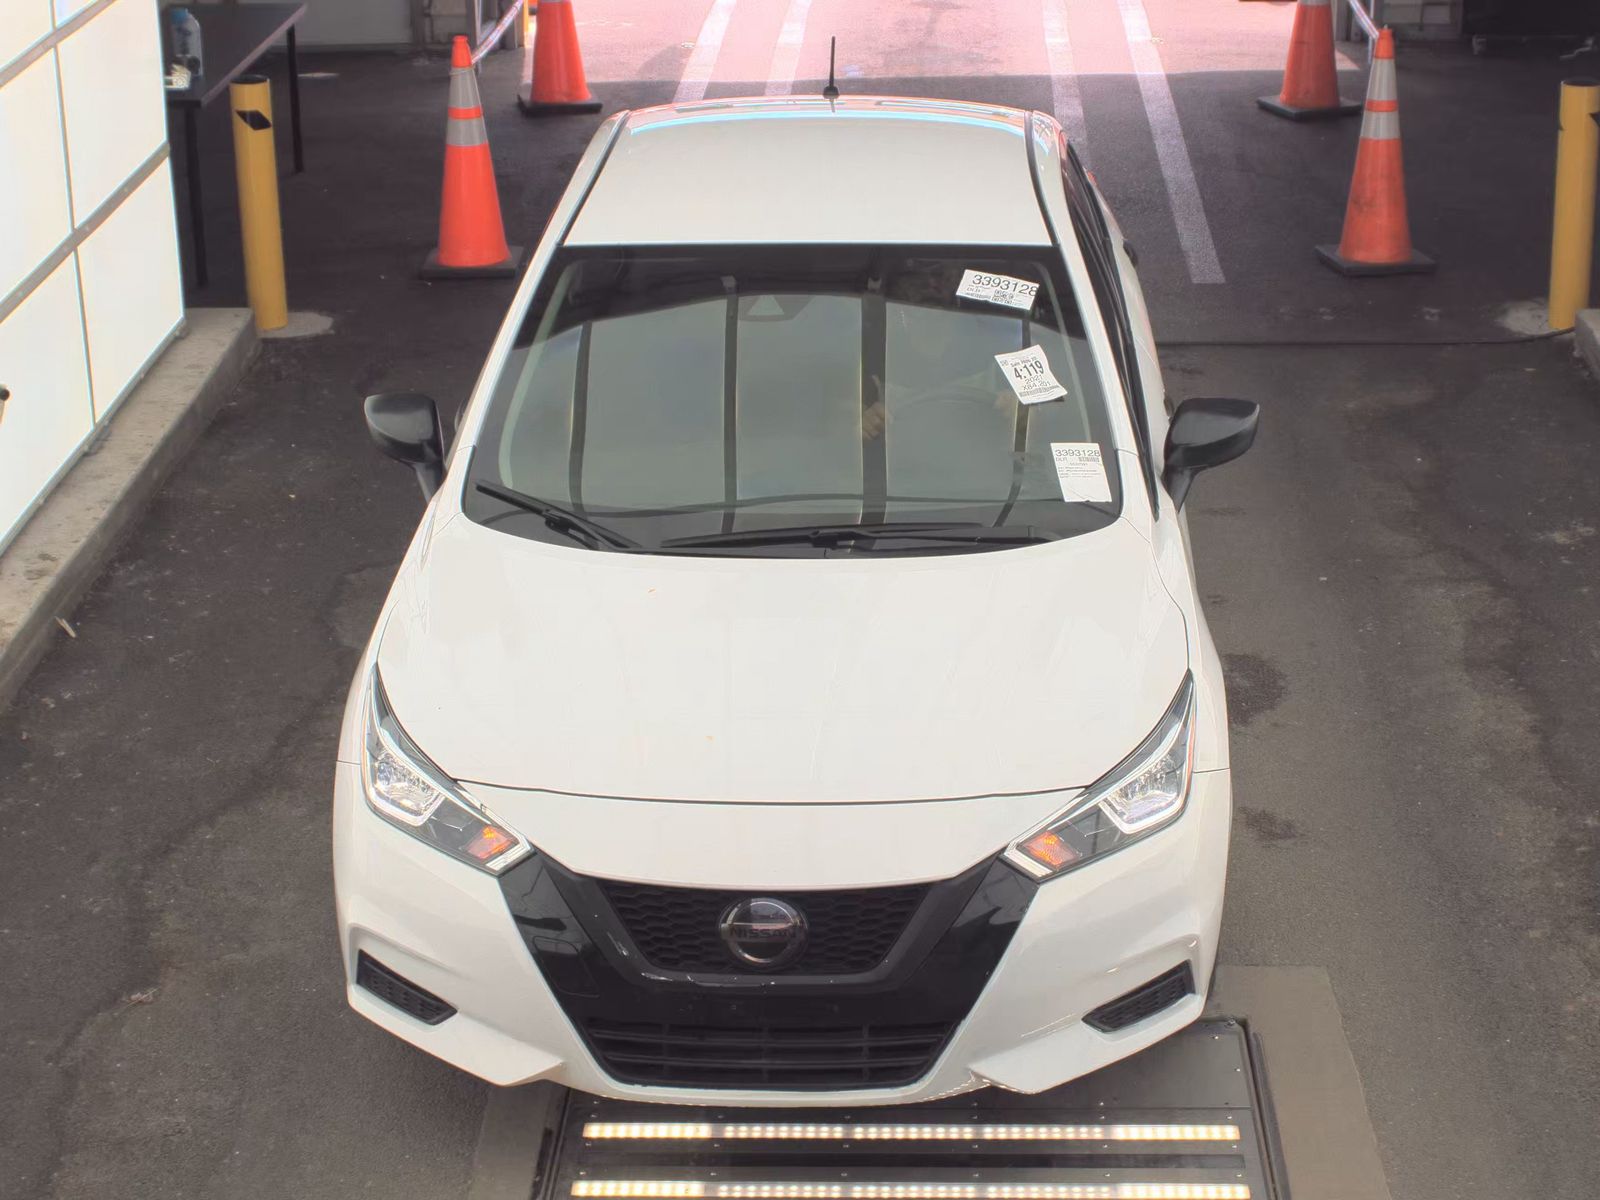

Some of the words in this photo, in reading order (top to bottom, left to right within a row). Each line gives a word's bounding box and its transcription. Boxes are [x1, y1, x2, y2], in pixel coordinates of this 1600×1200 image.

[972, 274, 1038, 297] 3393128
[1013, 360, 1045, 380] 4:119
[1025, 374, 1043, 385] 2021
[1055, 449, 1101, 457] 3393128
[729, 927, 797, 939] NISSAN
